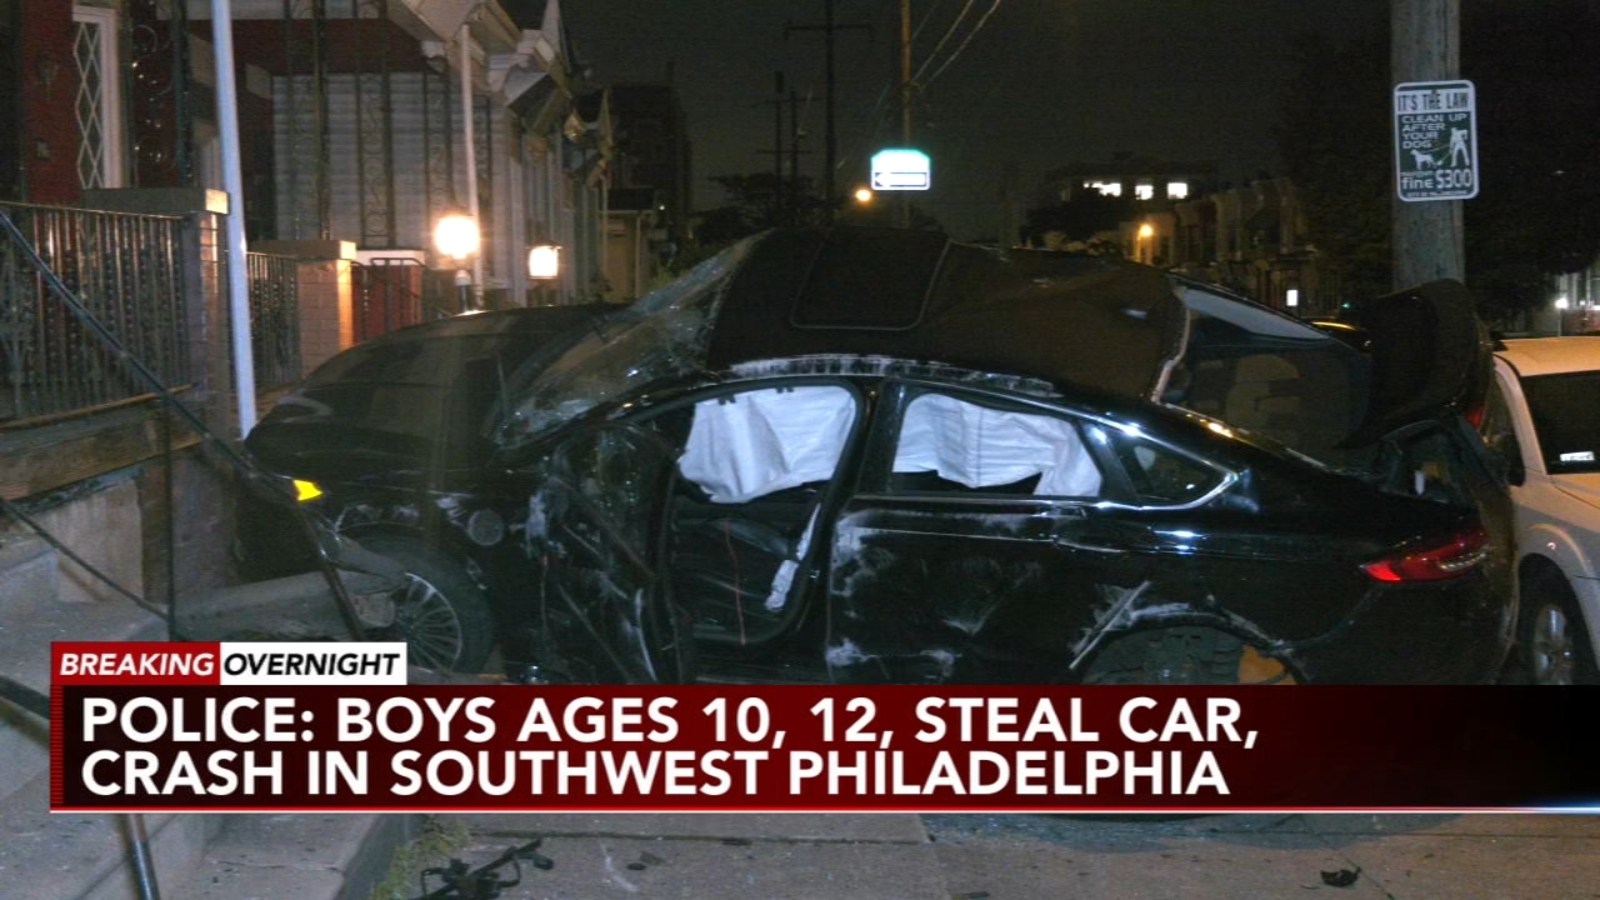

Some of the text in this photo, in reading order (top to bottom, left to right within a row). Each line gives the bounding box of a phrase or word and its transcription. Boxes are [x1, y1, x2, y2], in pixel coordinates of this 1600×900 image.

[1422, 91, 1441, 110] THE
[1446, 91, 1468, 109] LAW
[1402, 113, 1467, 124] CLEAN UP
[1402, 123, 1445, 132] AFTER
[1402, 132, 1438, 140] YOUR
[1403, 140, 1432, 149] DOG
[1402, 177, 1434, 189] fine
